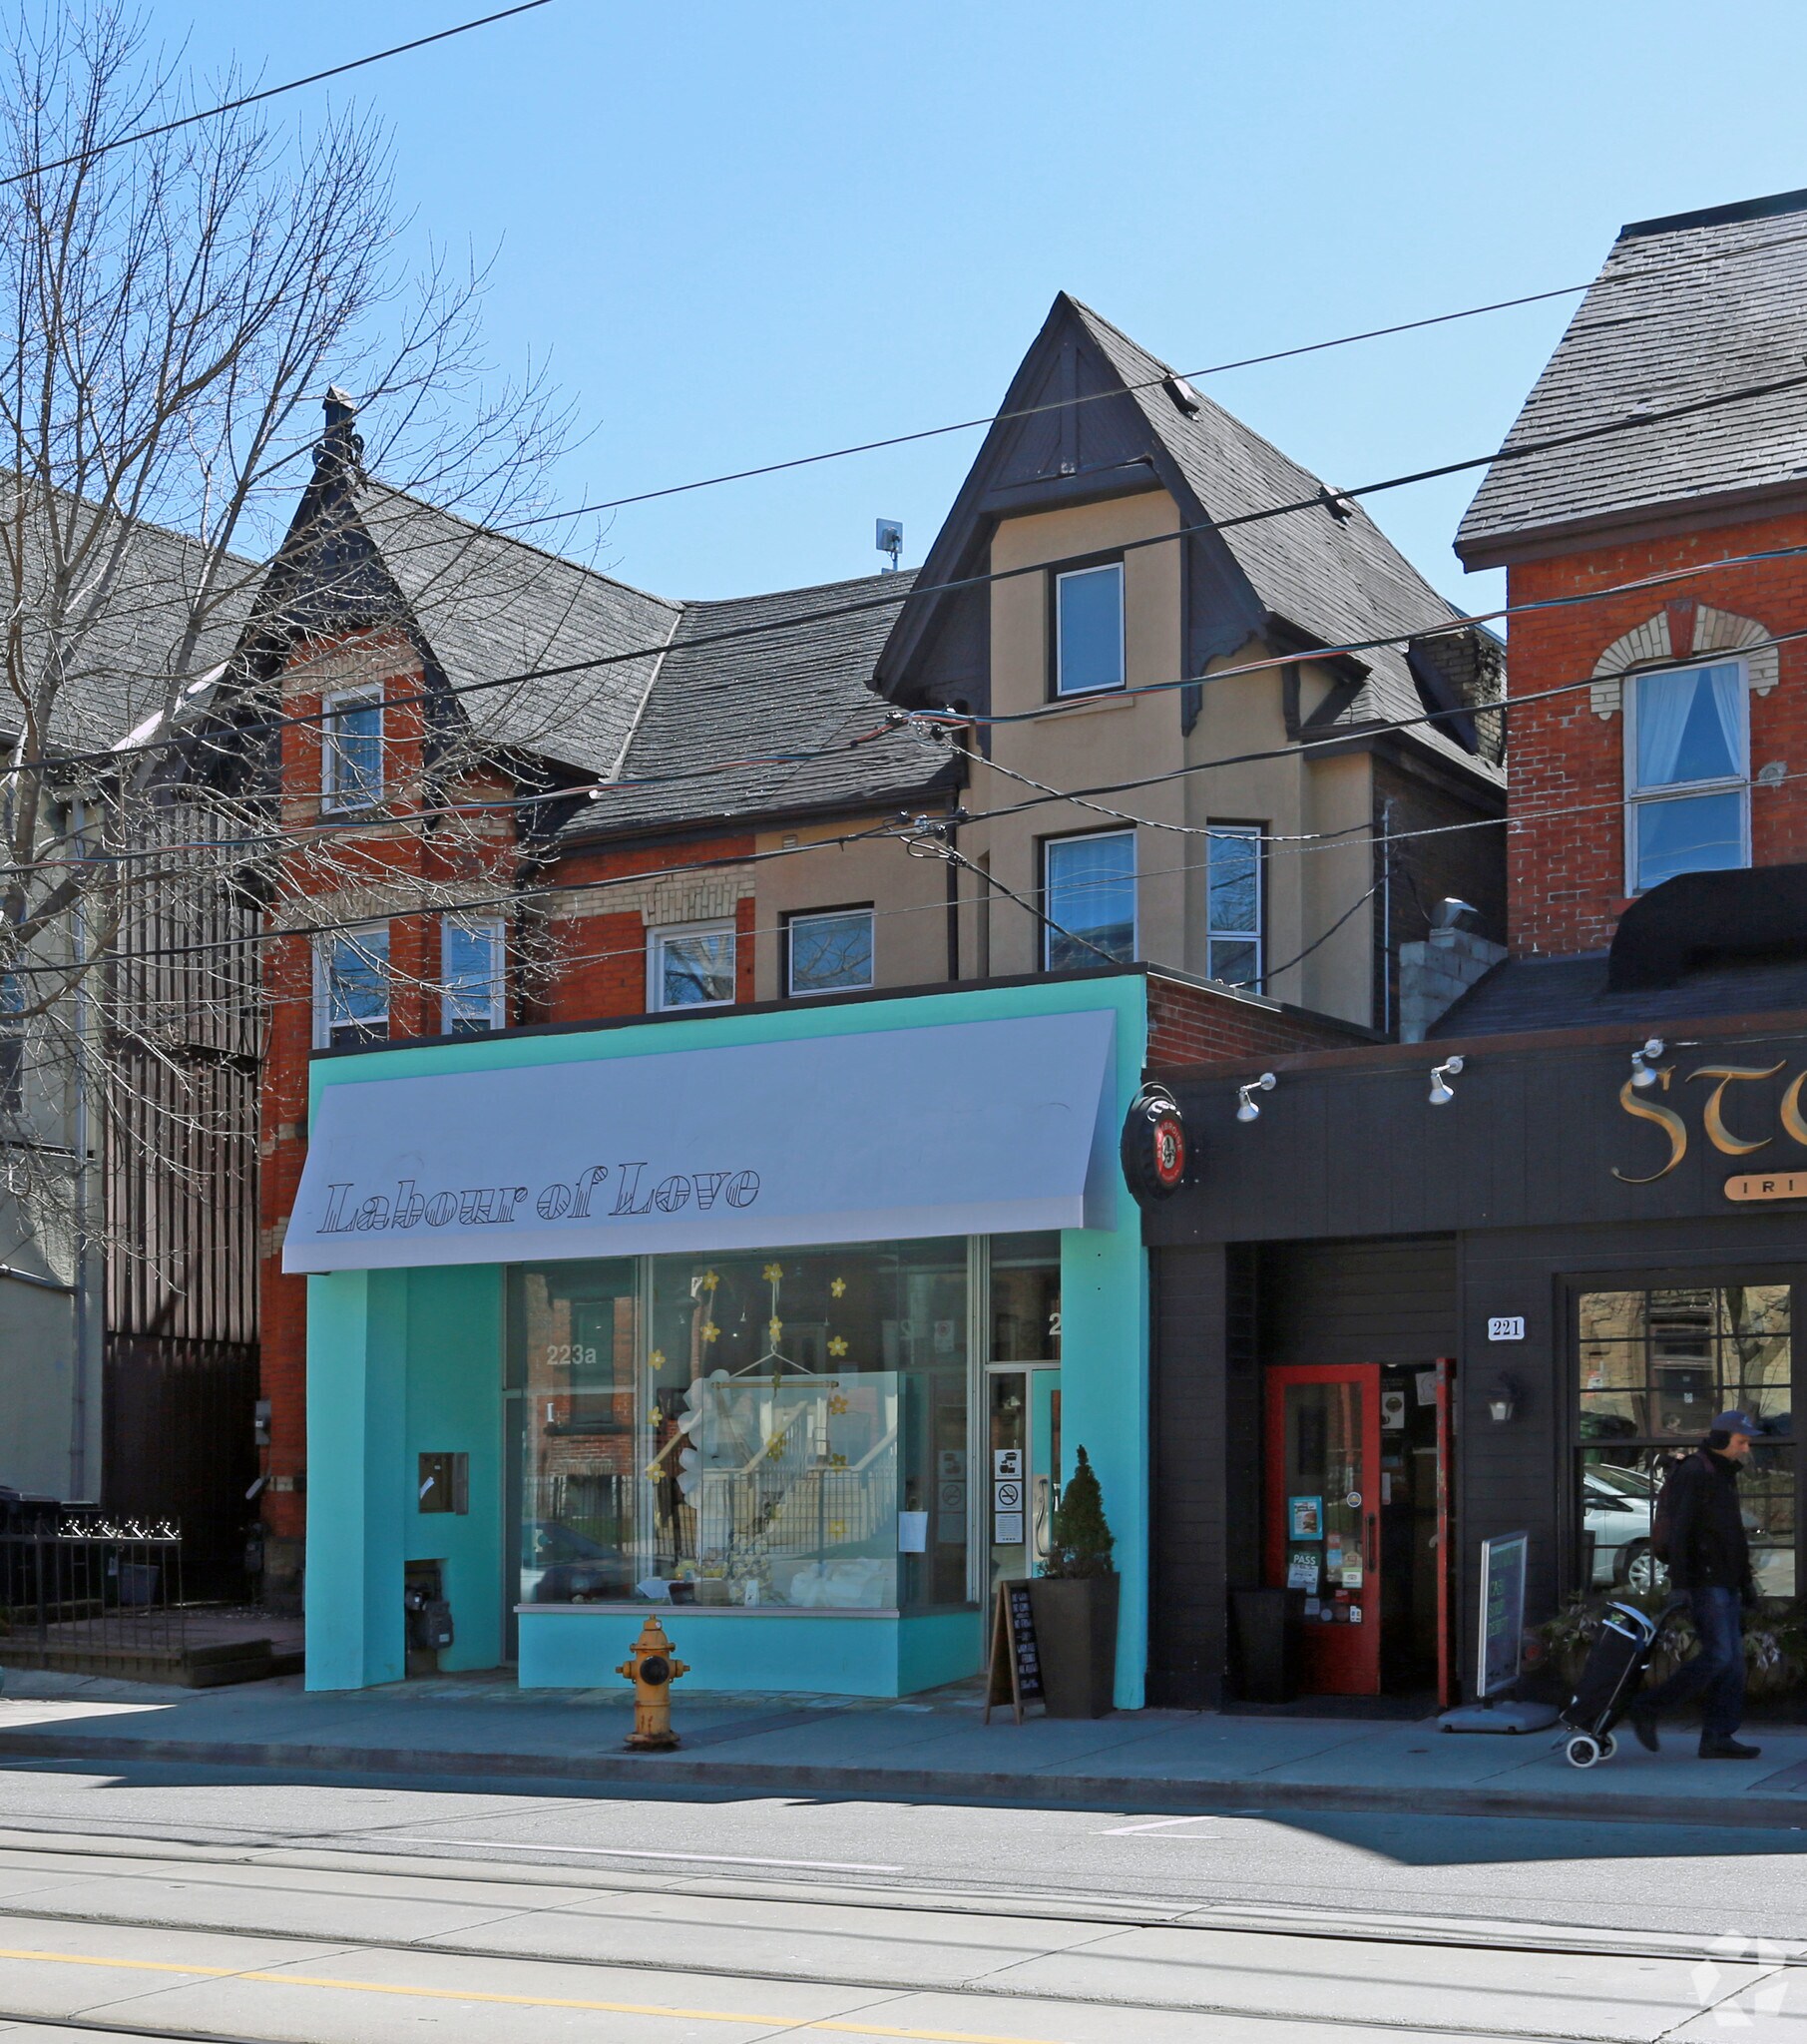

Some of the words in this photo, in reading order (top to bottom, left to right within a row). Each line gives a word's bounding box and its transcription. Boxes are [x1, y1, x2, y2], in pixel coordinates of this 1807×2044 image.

[316, 1179, 529, 1234] Labour
[536, 1165, 609, 1221] of
[607, 1162, 761, 1217] Love
[1493, 1319, 1521, 1335] 221
[546, 1343, 597, 1365] 223a
[1293, 1554, 1316, 1565] PASS
